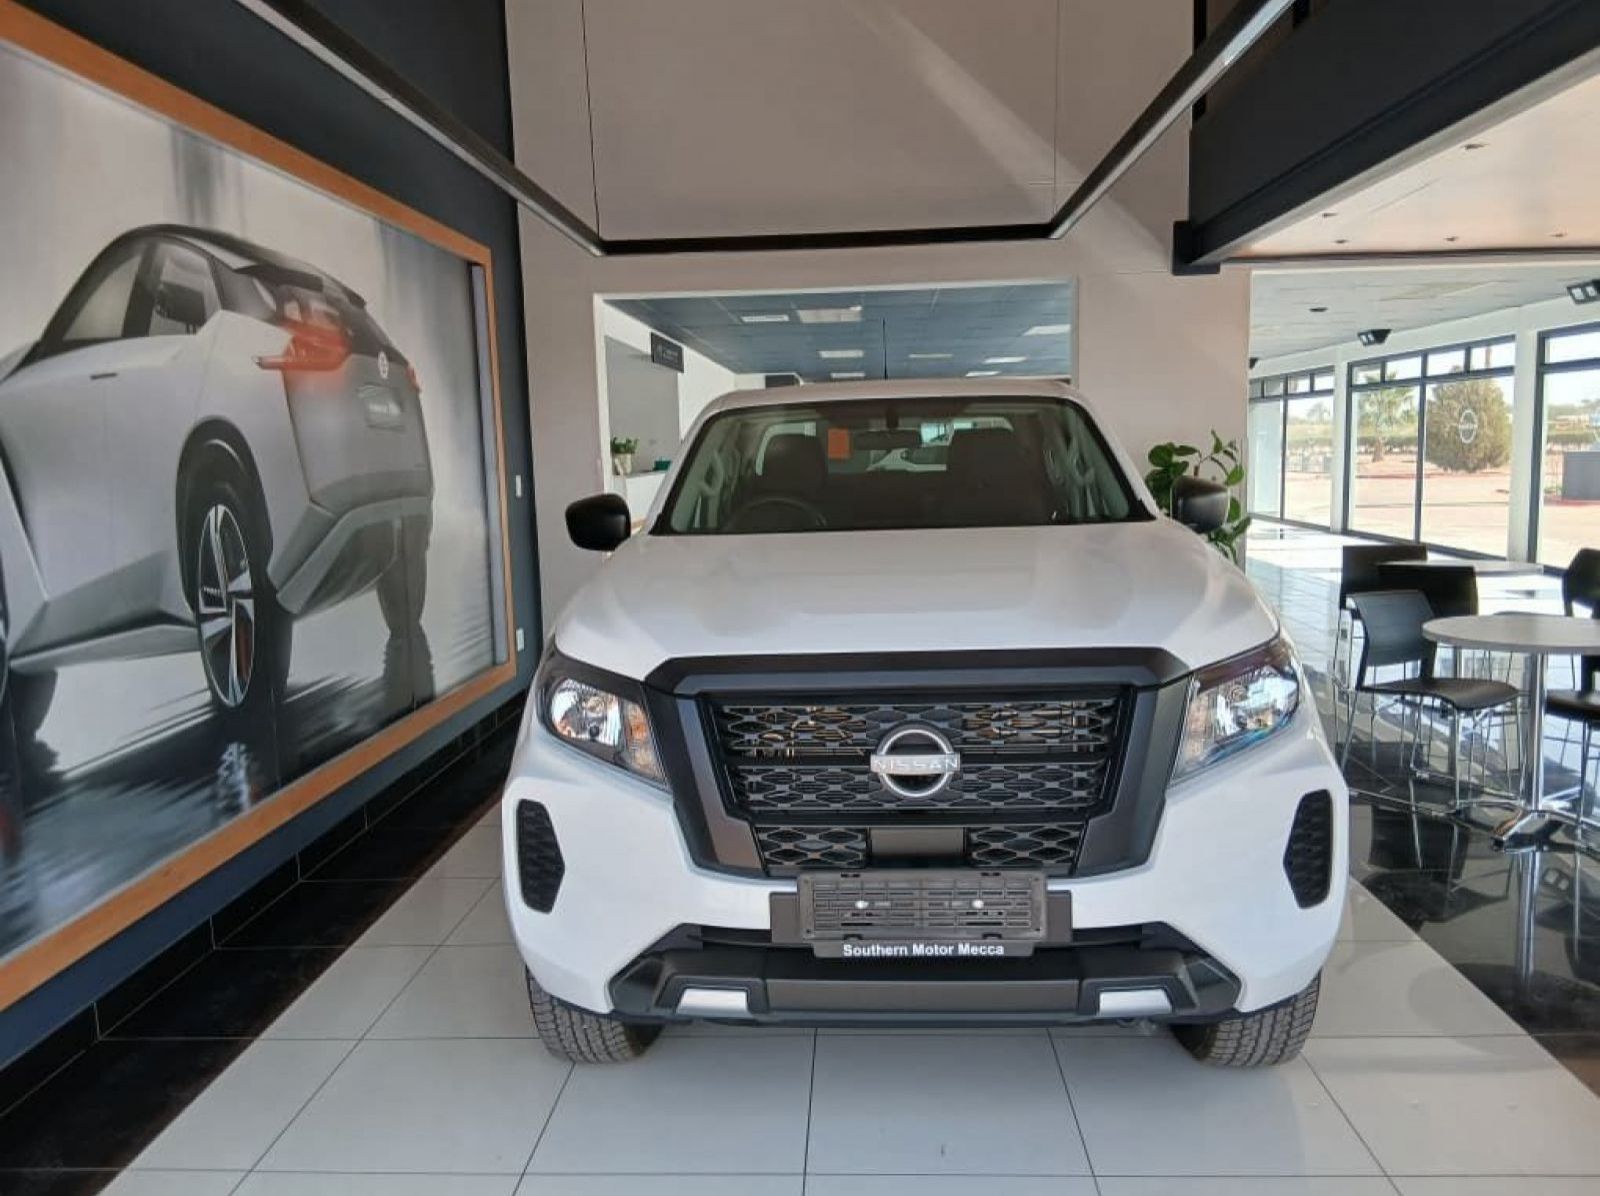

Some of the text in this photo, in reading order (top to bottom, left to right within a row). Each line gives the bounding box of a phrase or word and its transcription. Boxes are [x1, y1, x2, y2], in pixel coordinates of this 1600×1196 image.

[872, 757, 959, 770] NISSAN
[843, 942, 1005, 957] Southern Motor Mecca
